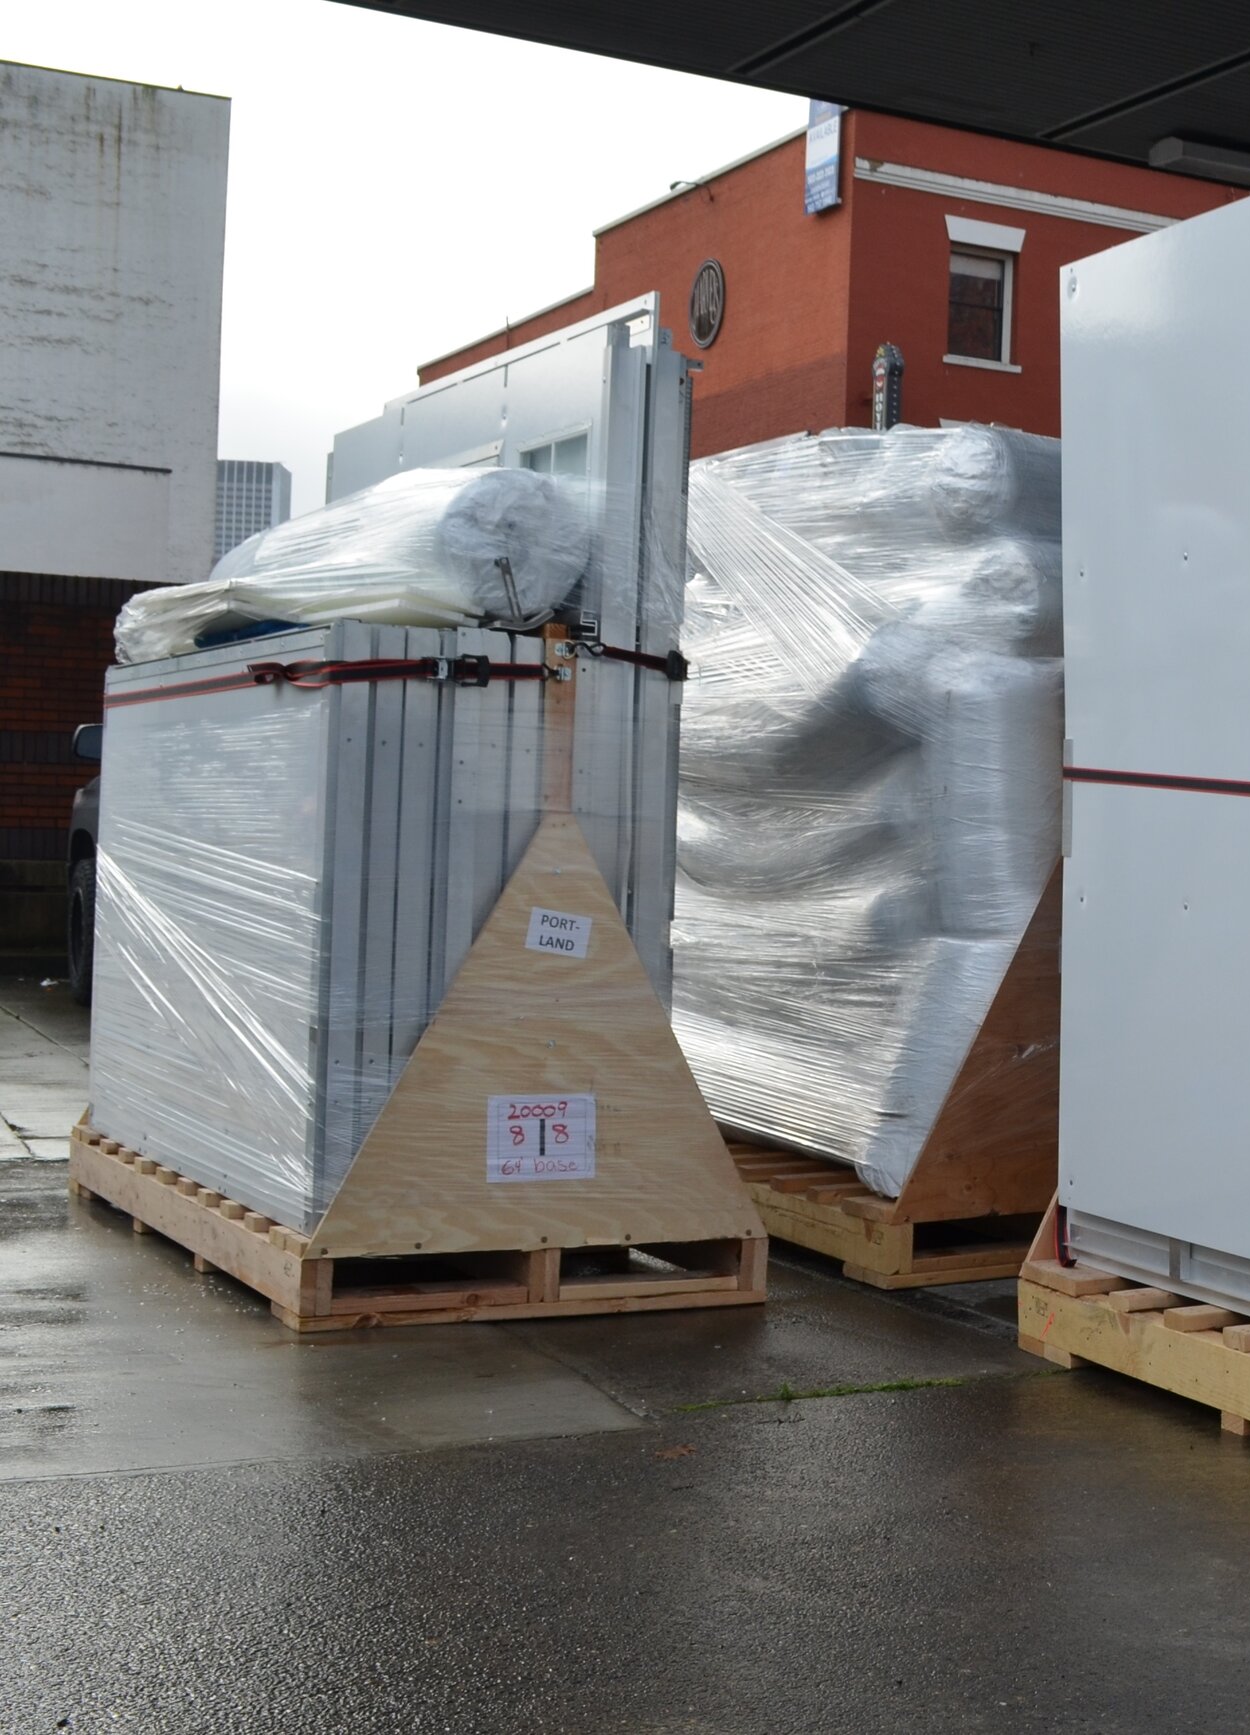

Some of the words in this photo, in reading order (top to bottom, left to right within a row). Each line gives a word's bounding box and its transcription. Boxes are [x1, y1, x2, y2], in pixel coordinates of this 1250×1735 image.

[541, 914, 580, 931] PORT-
[538, 935, 575, 951] LAND
[507, 1101, 568, 1120] 20009
[509, 1125, 525, 1146] 8
[552, 1123, 569, 1144] 8
[534, 1158, 577, 1174] base
